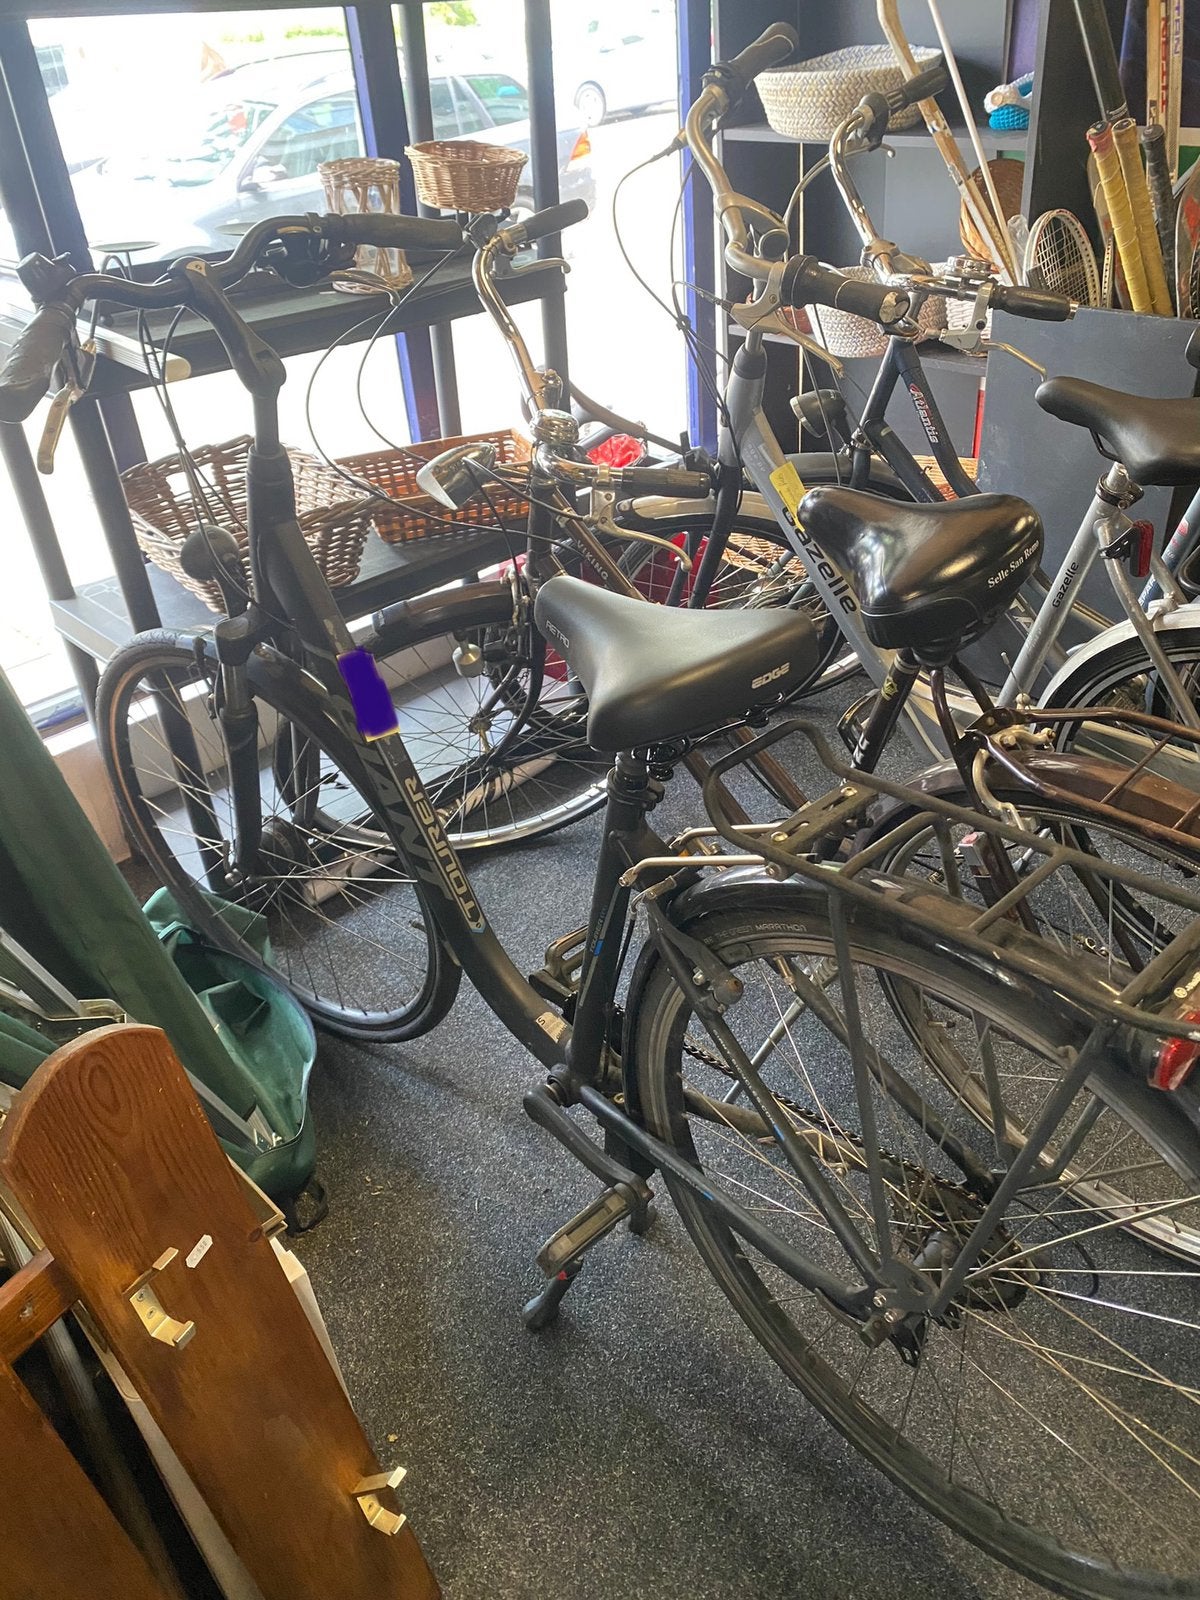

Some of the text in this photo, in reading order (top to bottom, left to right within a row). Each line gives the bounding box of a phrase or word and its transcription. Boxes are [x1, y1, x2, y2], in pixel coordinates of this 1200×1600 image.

[986, 566, 1010, 589] Selle
[1008, 554, 1026, 574] San
[1052, 562, 1079, 608] Gazelle
[545, 620, 570, 649] RETRO
[751, 662, 791, 690] EDGE
[403, 775, 474, 920] TOURER
[755, 922, 807, 932] MARATHON
